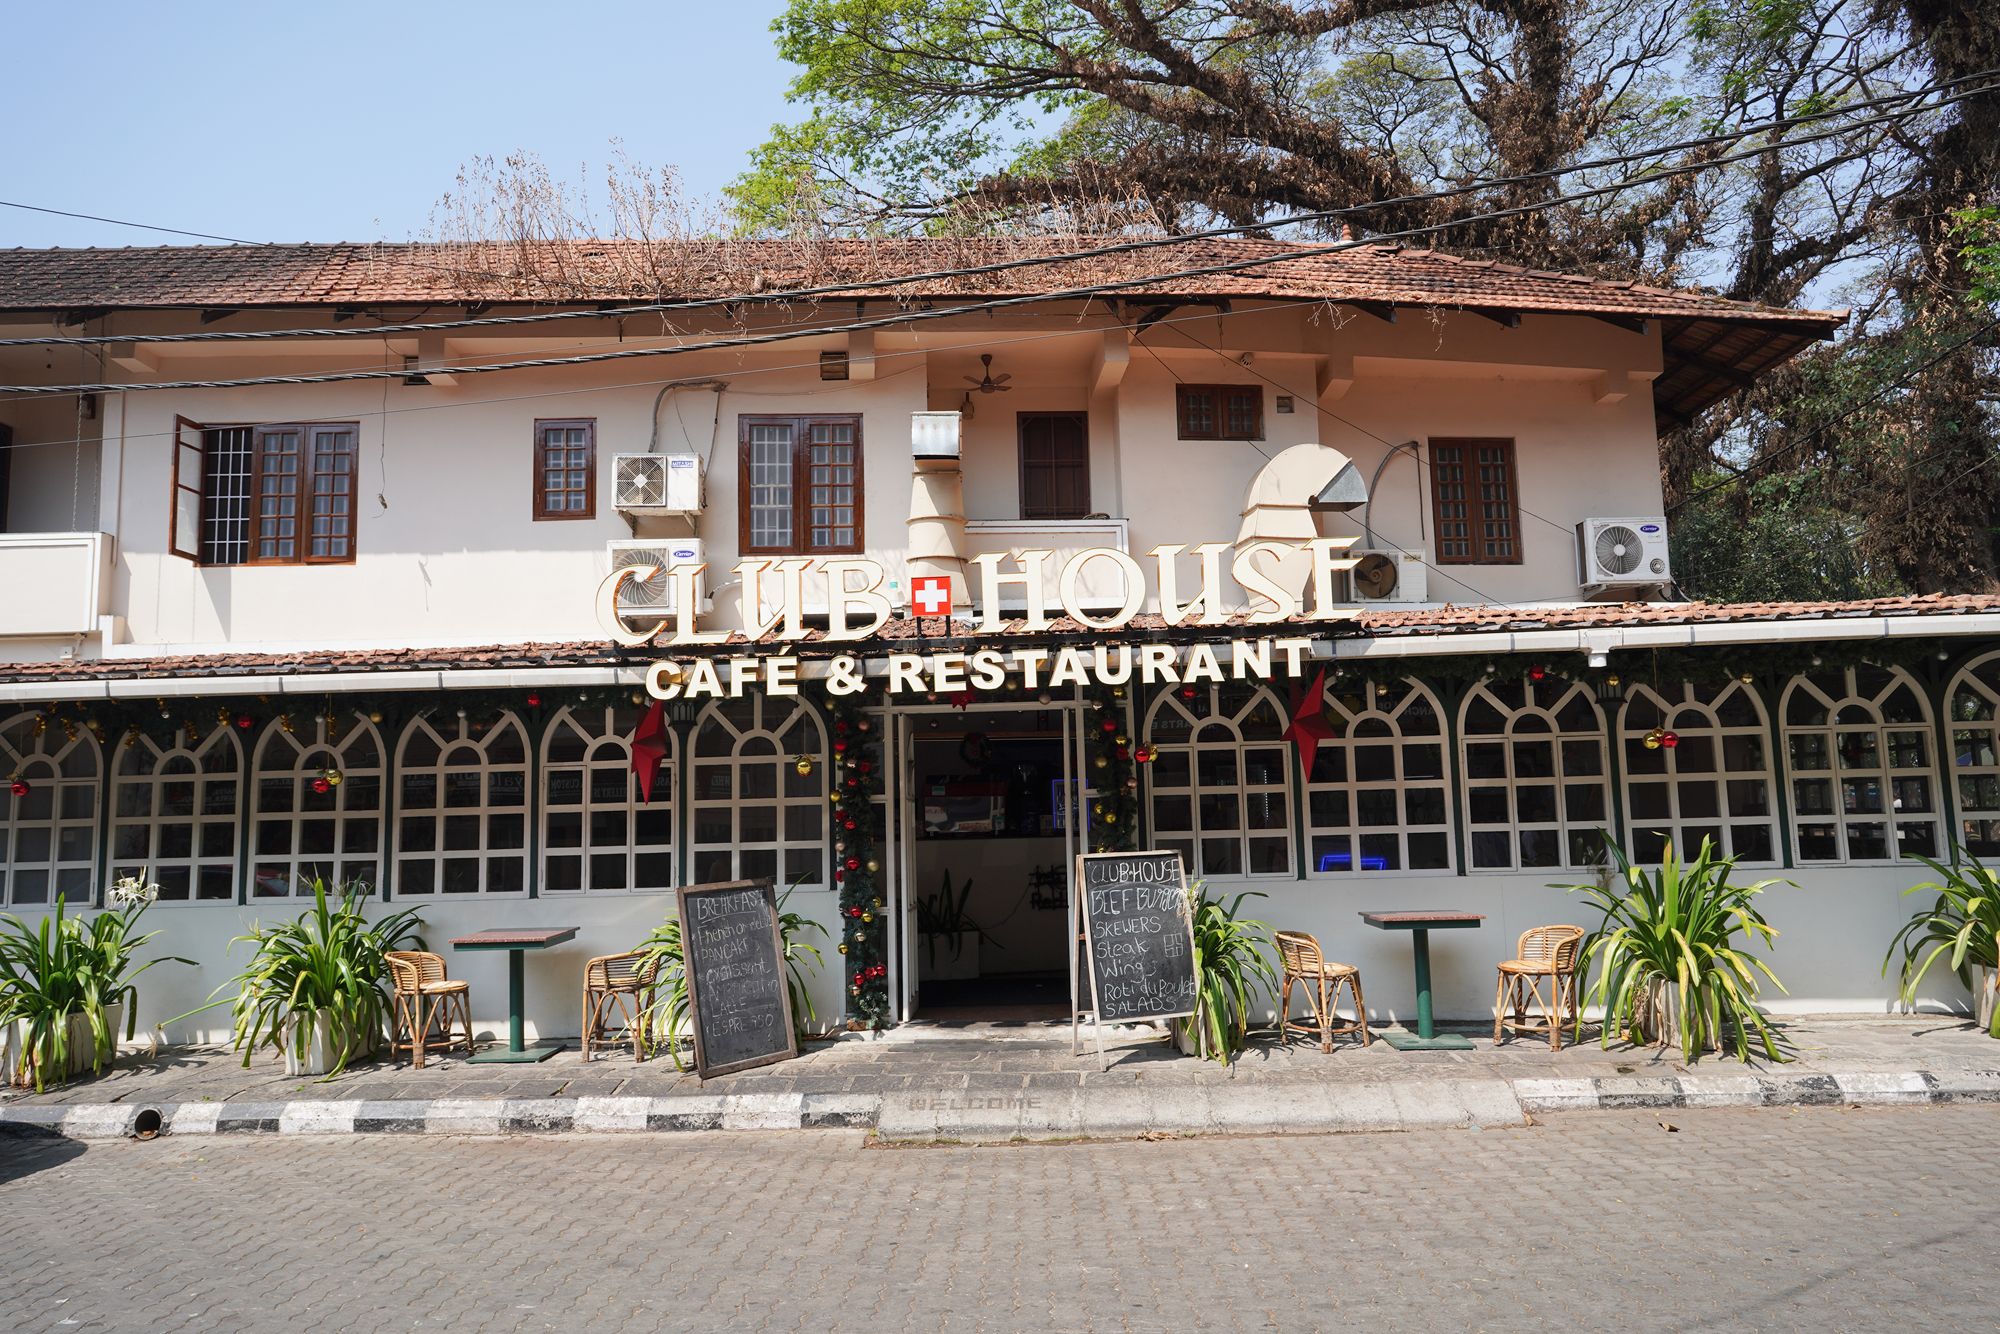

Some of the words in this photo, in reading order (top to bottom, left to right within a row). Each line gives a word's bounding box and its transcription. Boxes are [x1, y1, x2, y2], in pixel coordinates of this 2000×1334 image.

[595, 559, 892, 646] CLUB
[969, 536, 1366, 635] HOUSE
[645, 647, 799, 700] CAFÉ
[826, 654, 868, 696] &
[888, 639, 1312, 694] RESTAURANT
[1091, 888, 1133, 915] BEEF
[1094, 916, 1161, 939] SKEWERS
[1096, 936, 1151, 959] Steak
[1104, 996, 1177, 1017] SALADS
[908, 1097, 1041, 1111] WELCOME
